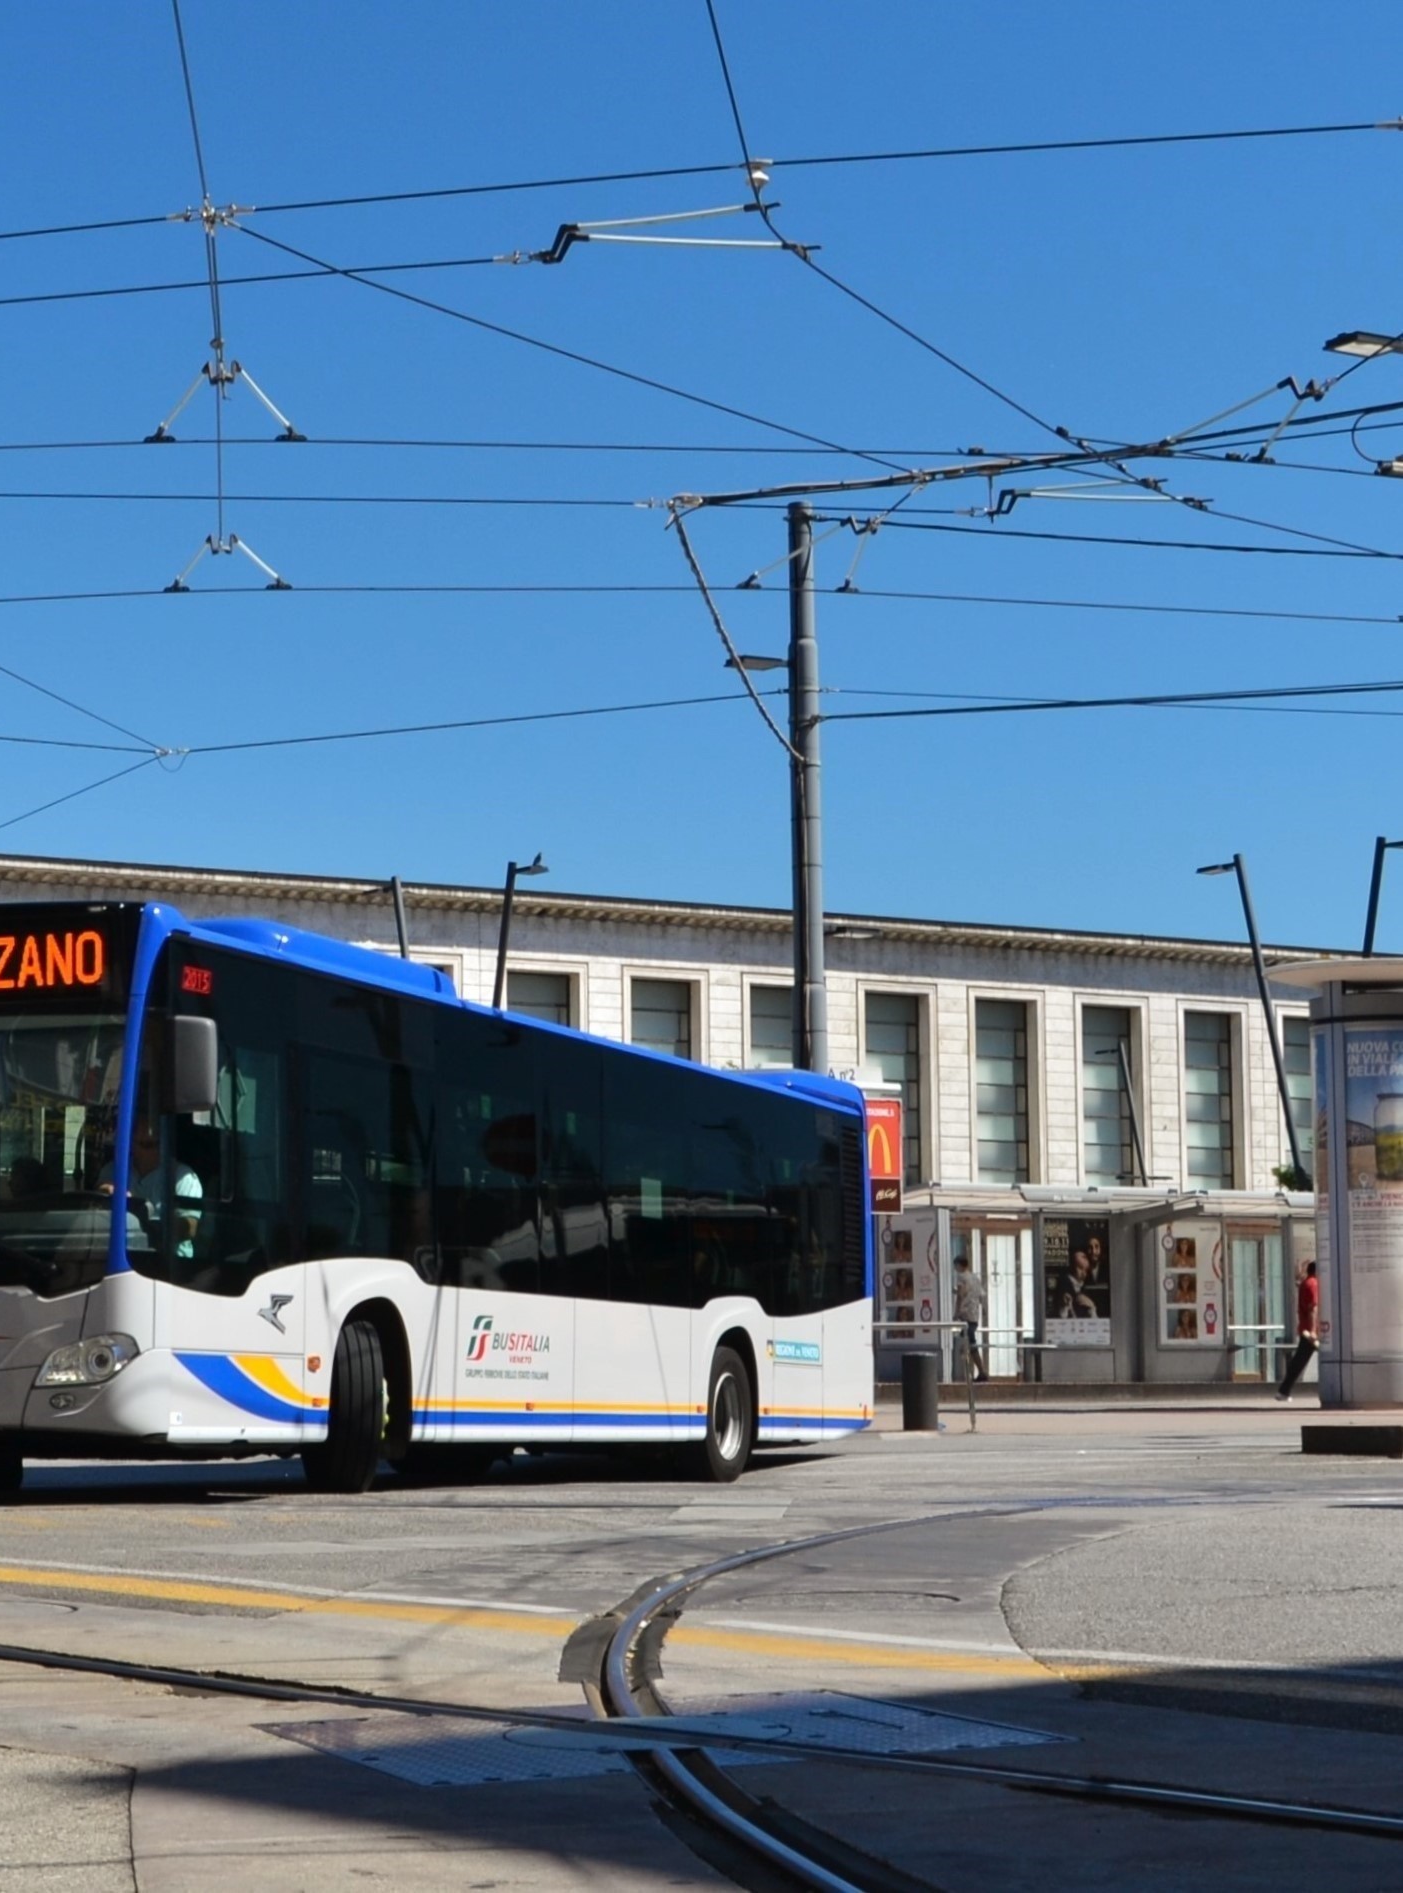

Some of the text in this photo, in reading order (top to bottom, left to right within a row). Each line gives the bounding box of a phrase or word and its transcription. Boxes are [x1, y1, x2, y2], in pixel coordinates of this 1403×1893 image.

[184, 967, 210, 992] 2015
[1347, 1041, 1390, 1054] NUOVA
[1347, 1053, 1360, 1065] IN
[1348, 1064, 1388, 1077] DELLA
[491, 1332, 550, 1352] BUSITALIA
[509, 1355, 532, 1364] VENETO
